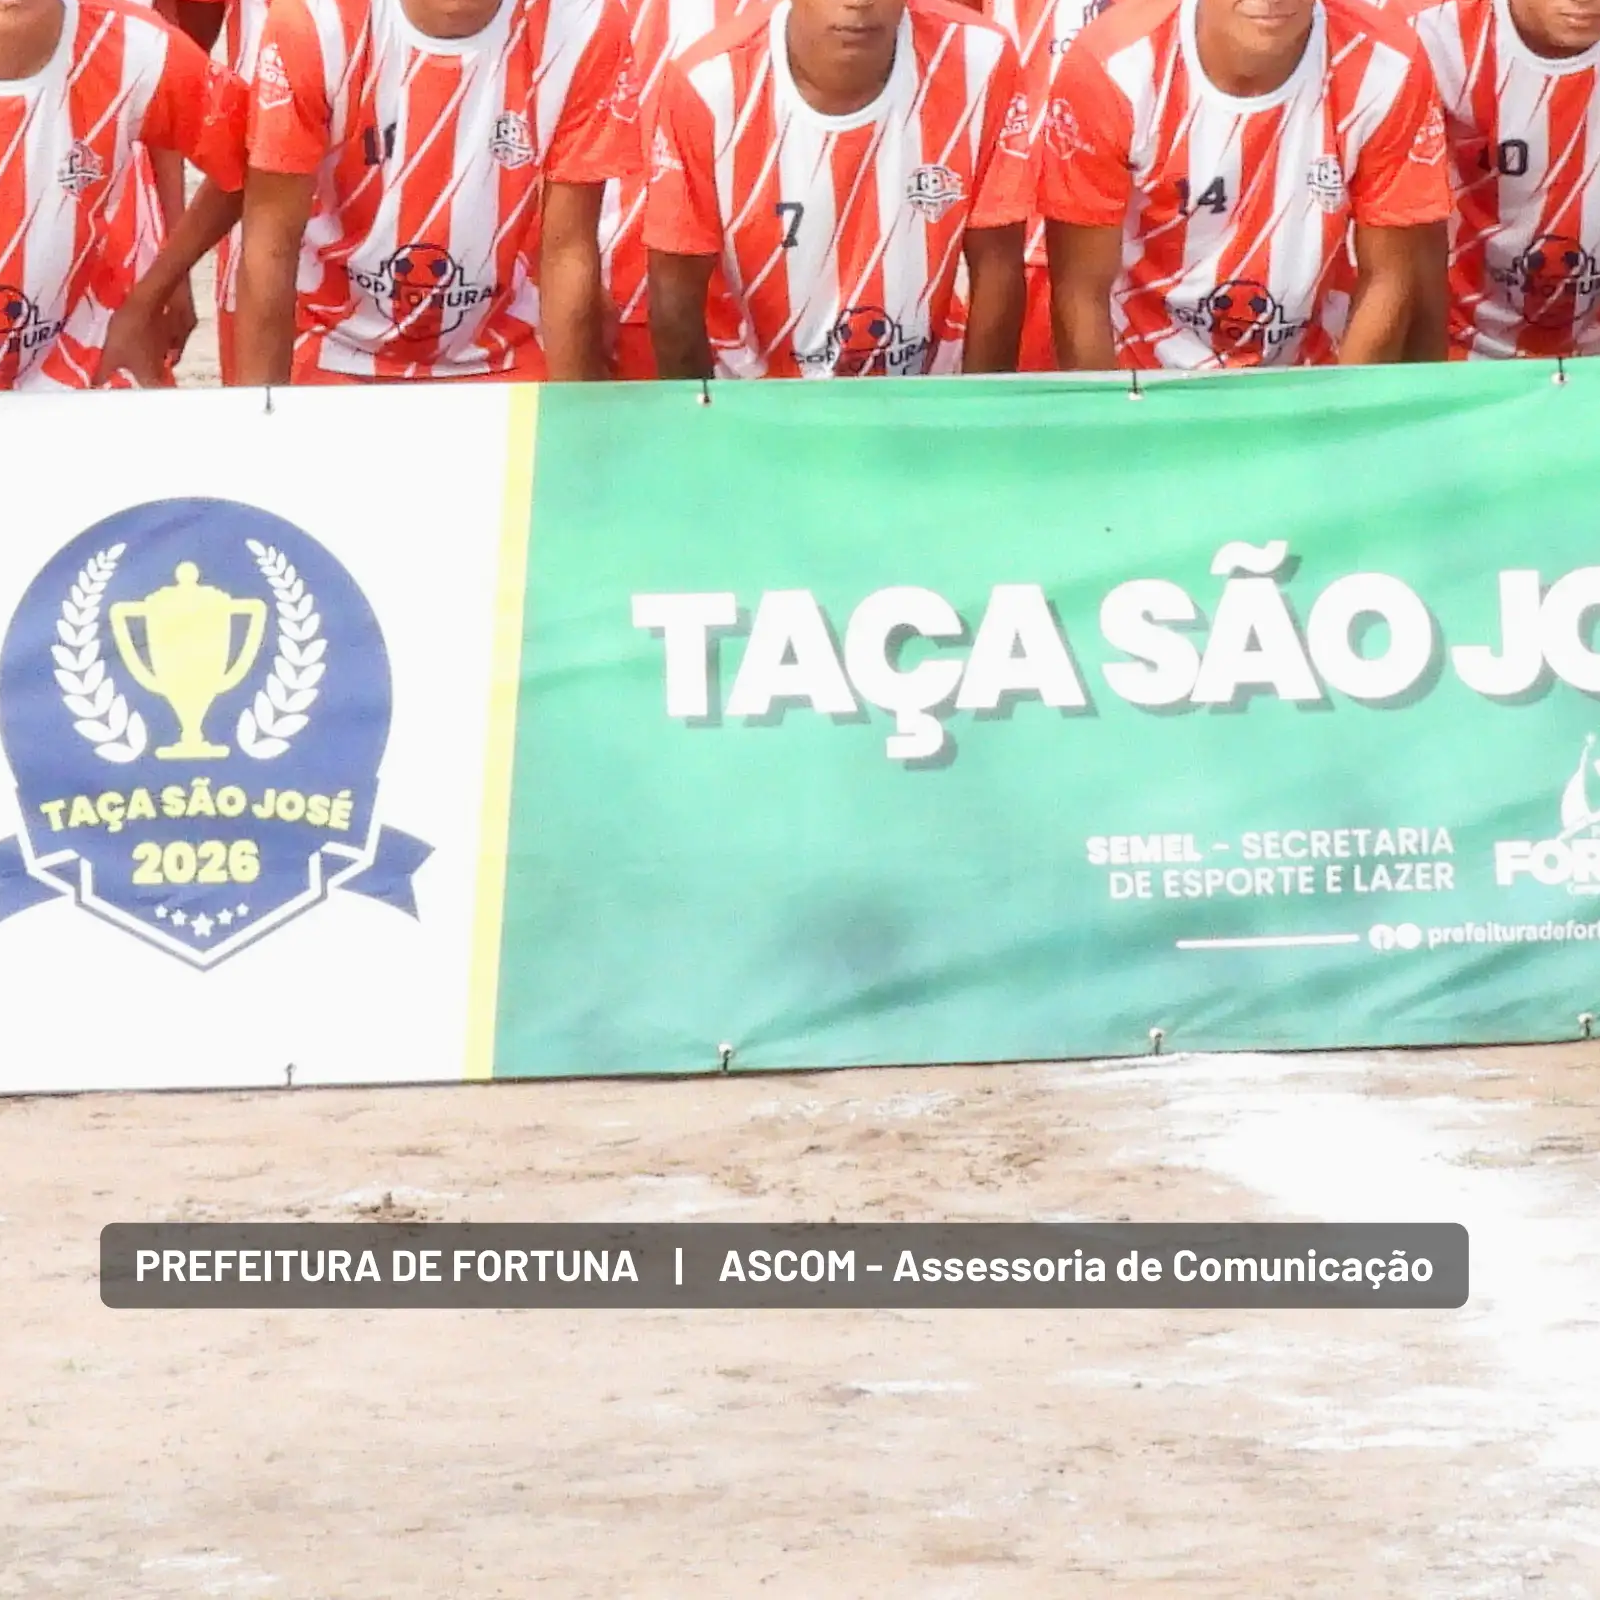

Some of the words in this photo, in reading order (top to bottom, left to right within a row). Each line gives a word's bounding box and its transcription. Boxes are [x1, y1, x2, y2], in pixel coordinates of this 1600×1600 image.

[1175, 177, 1227, 215] 14
[776, 201, 804, 250] 7
[631, 584, 1088, 760] TAÇA
[1099, 539, 1434, 706] SÃO
[40, 785, 158, 832] TAÇA
[161, 777, 245, 819] SÃO
[252, 790, 354, 831] JOSÉ
[131, 840, 261, 885] 2026
[1086, 834, 1203, 865] SEMEL
[1242, 827, 1454, 860] SECRETARIA
[1109, 870, 1153, 899] DE
[1163, 865, 1314, 898] ESPORTE
[1326, 864, 1342, 892] E
[1354, 861, 1454, 892] LAZER
